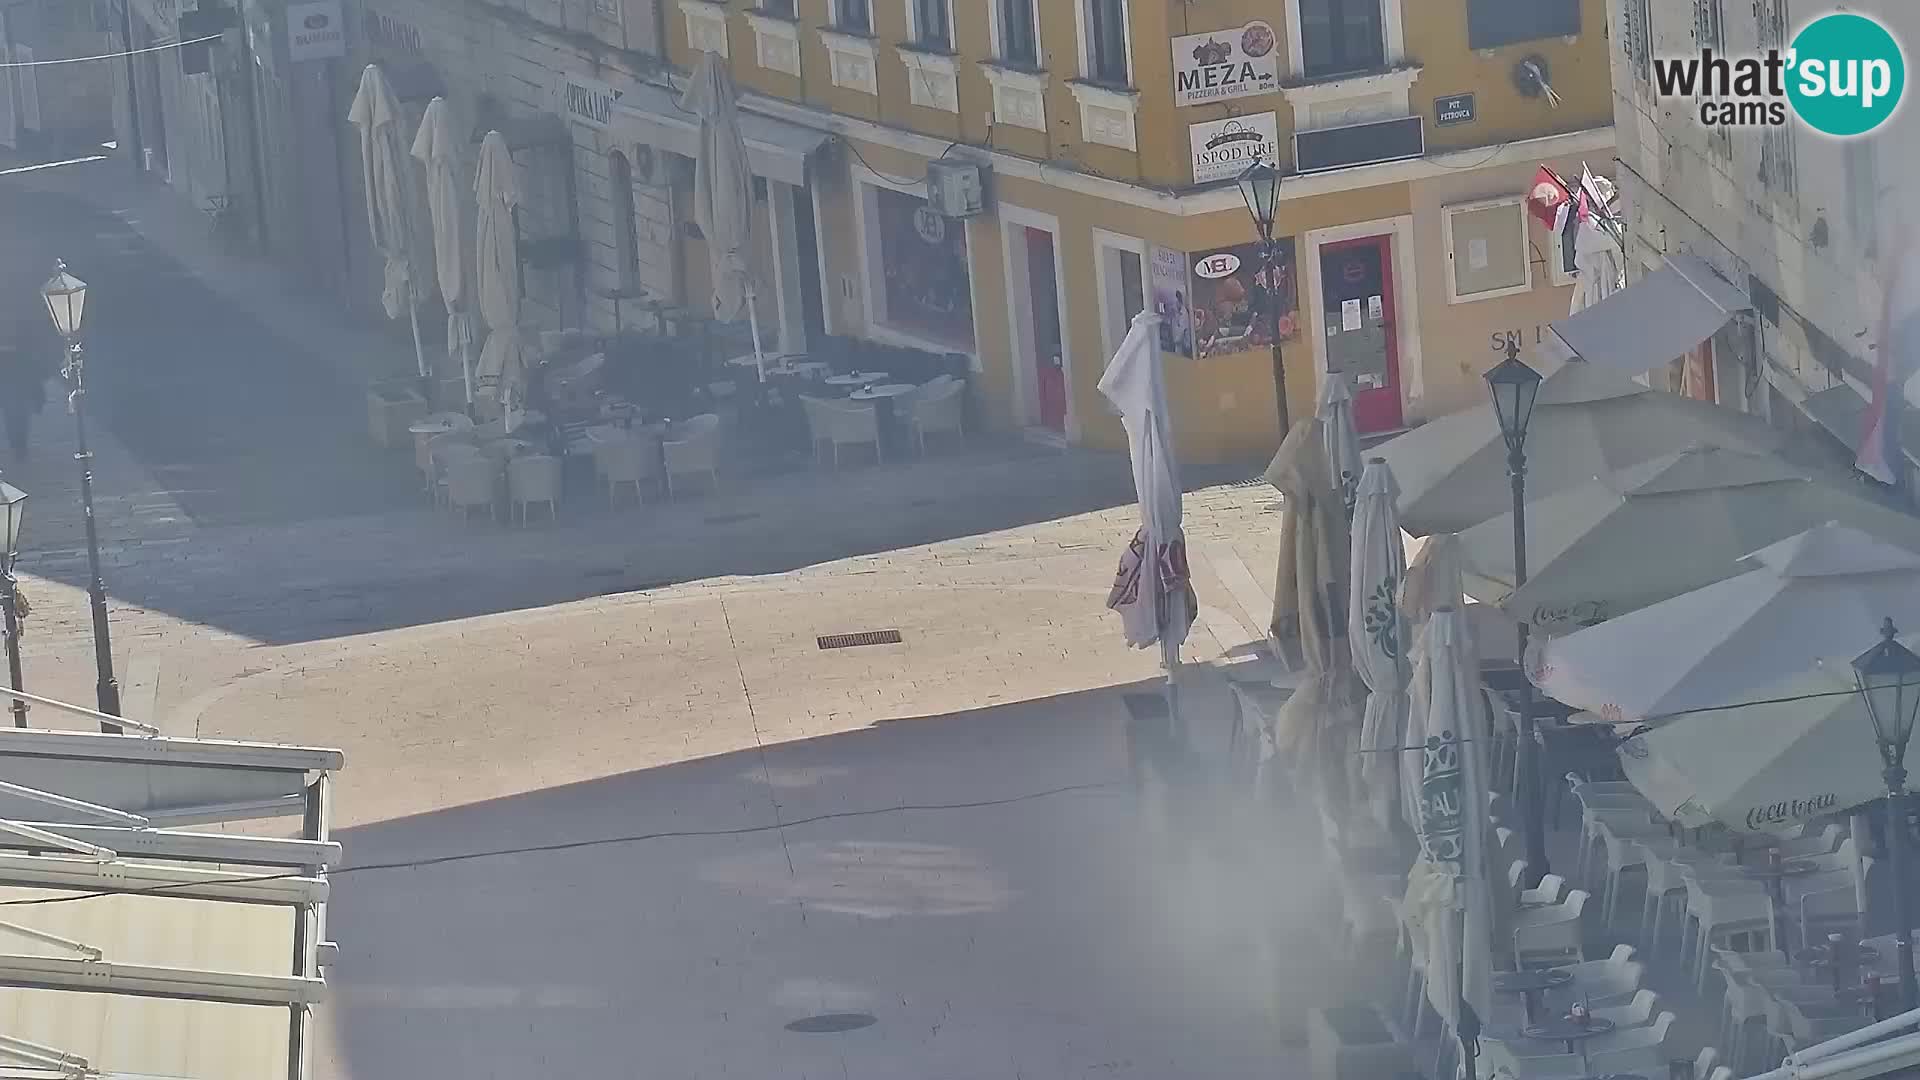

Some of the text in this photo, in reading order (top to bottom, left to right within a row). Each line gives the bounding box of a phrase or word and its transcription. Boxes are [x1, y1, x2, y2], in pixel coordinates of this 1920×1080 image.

[1178, 61, 1257, 92] MEZA
[1187, 83, 1249, 100] PIZZERIA & GRILL
[1449, 100, 1460, 109] PUT
[1440, 109, 1471, 121] PETROVCA
[1196, 147, 1242, 166] ISPOD
